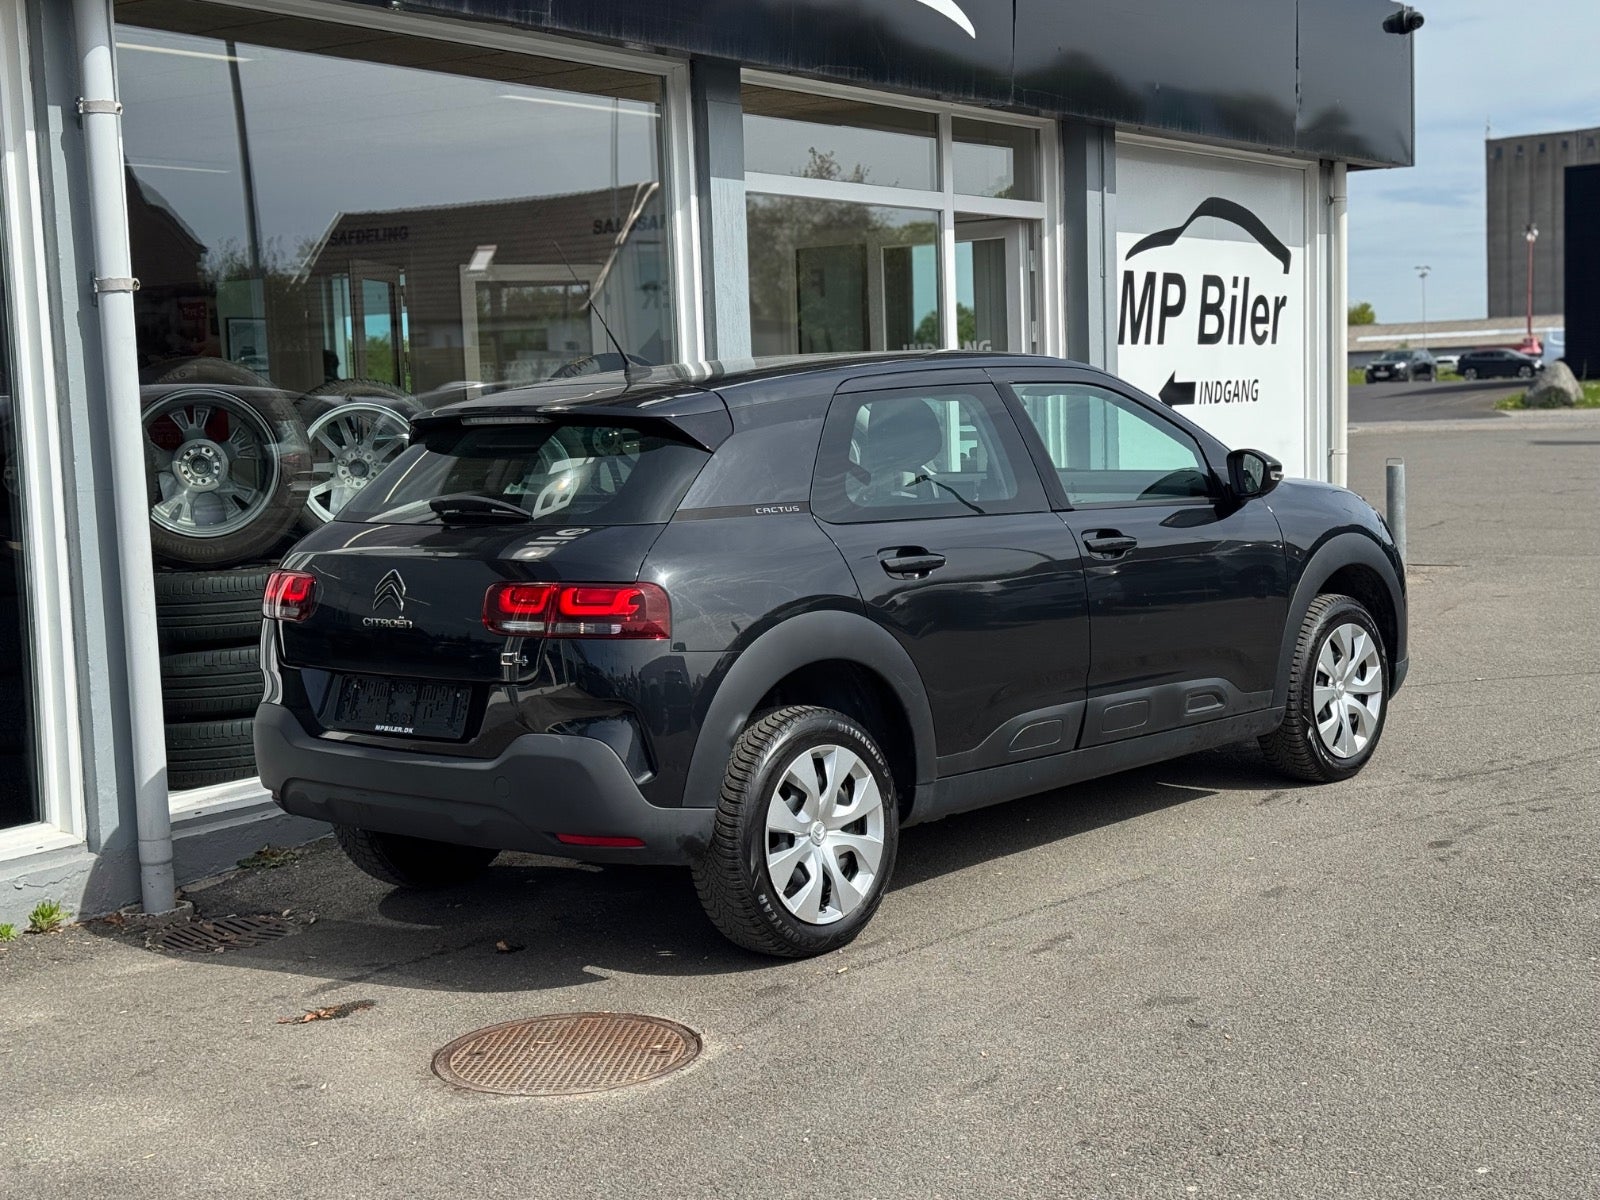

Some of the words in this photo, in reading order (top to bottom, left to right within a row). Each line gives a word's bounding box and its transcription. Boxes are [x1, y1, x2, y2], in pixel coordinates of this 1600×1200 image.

[1117, 270, 1187, 345] MP
[1197, 274, 1288, 346] Biler
[1199, 379, 1259, 405] INDGANG
[755, 505, 800, 514] CACTUS
[362, 615, 413, 629] CITROËN
[500, 651, 529, 667] C4
[375, 724, 414, 734] MPBILER.DK
